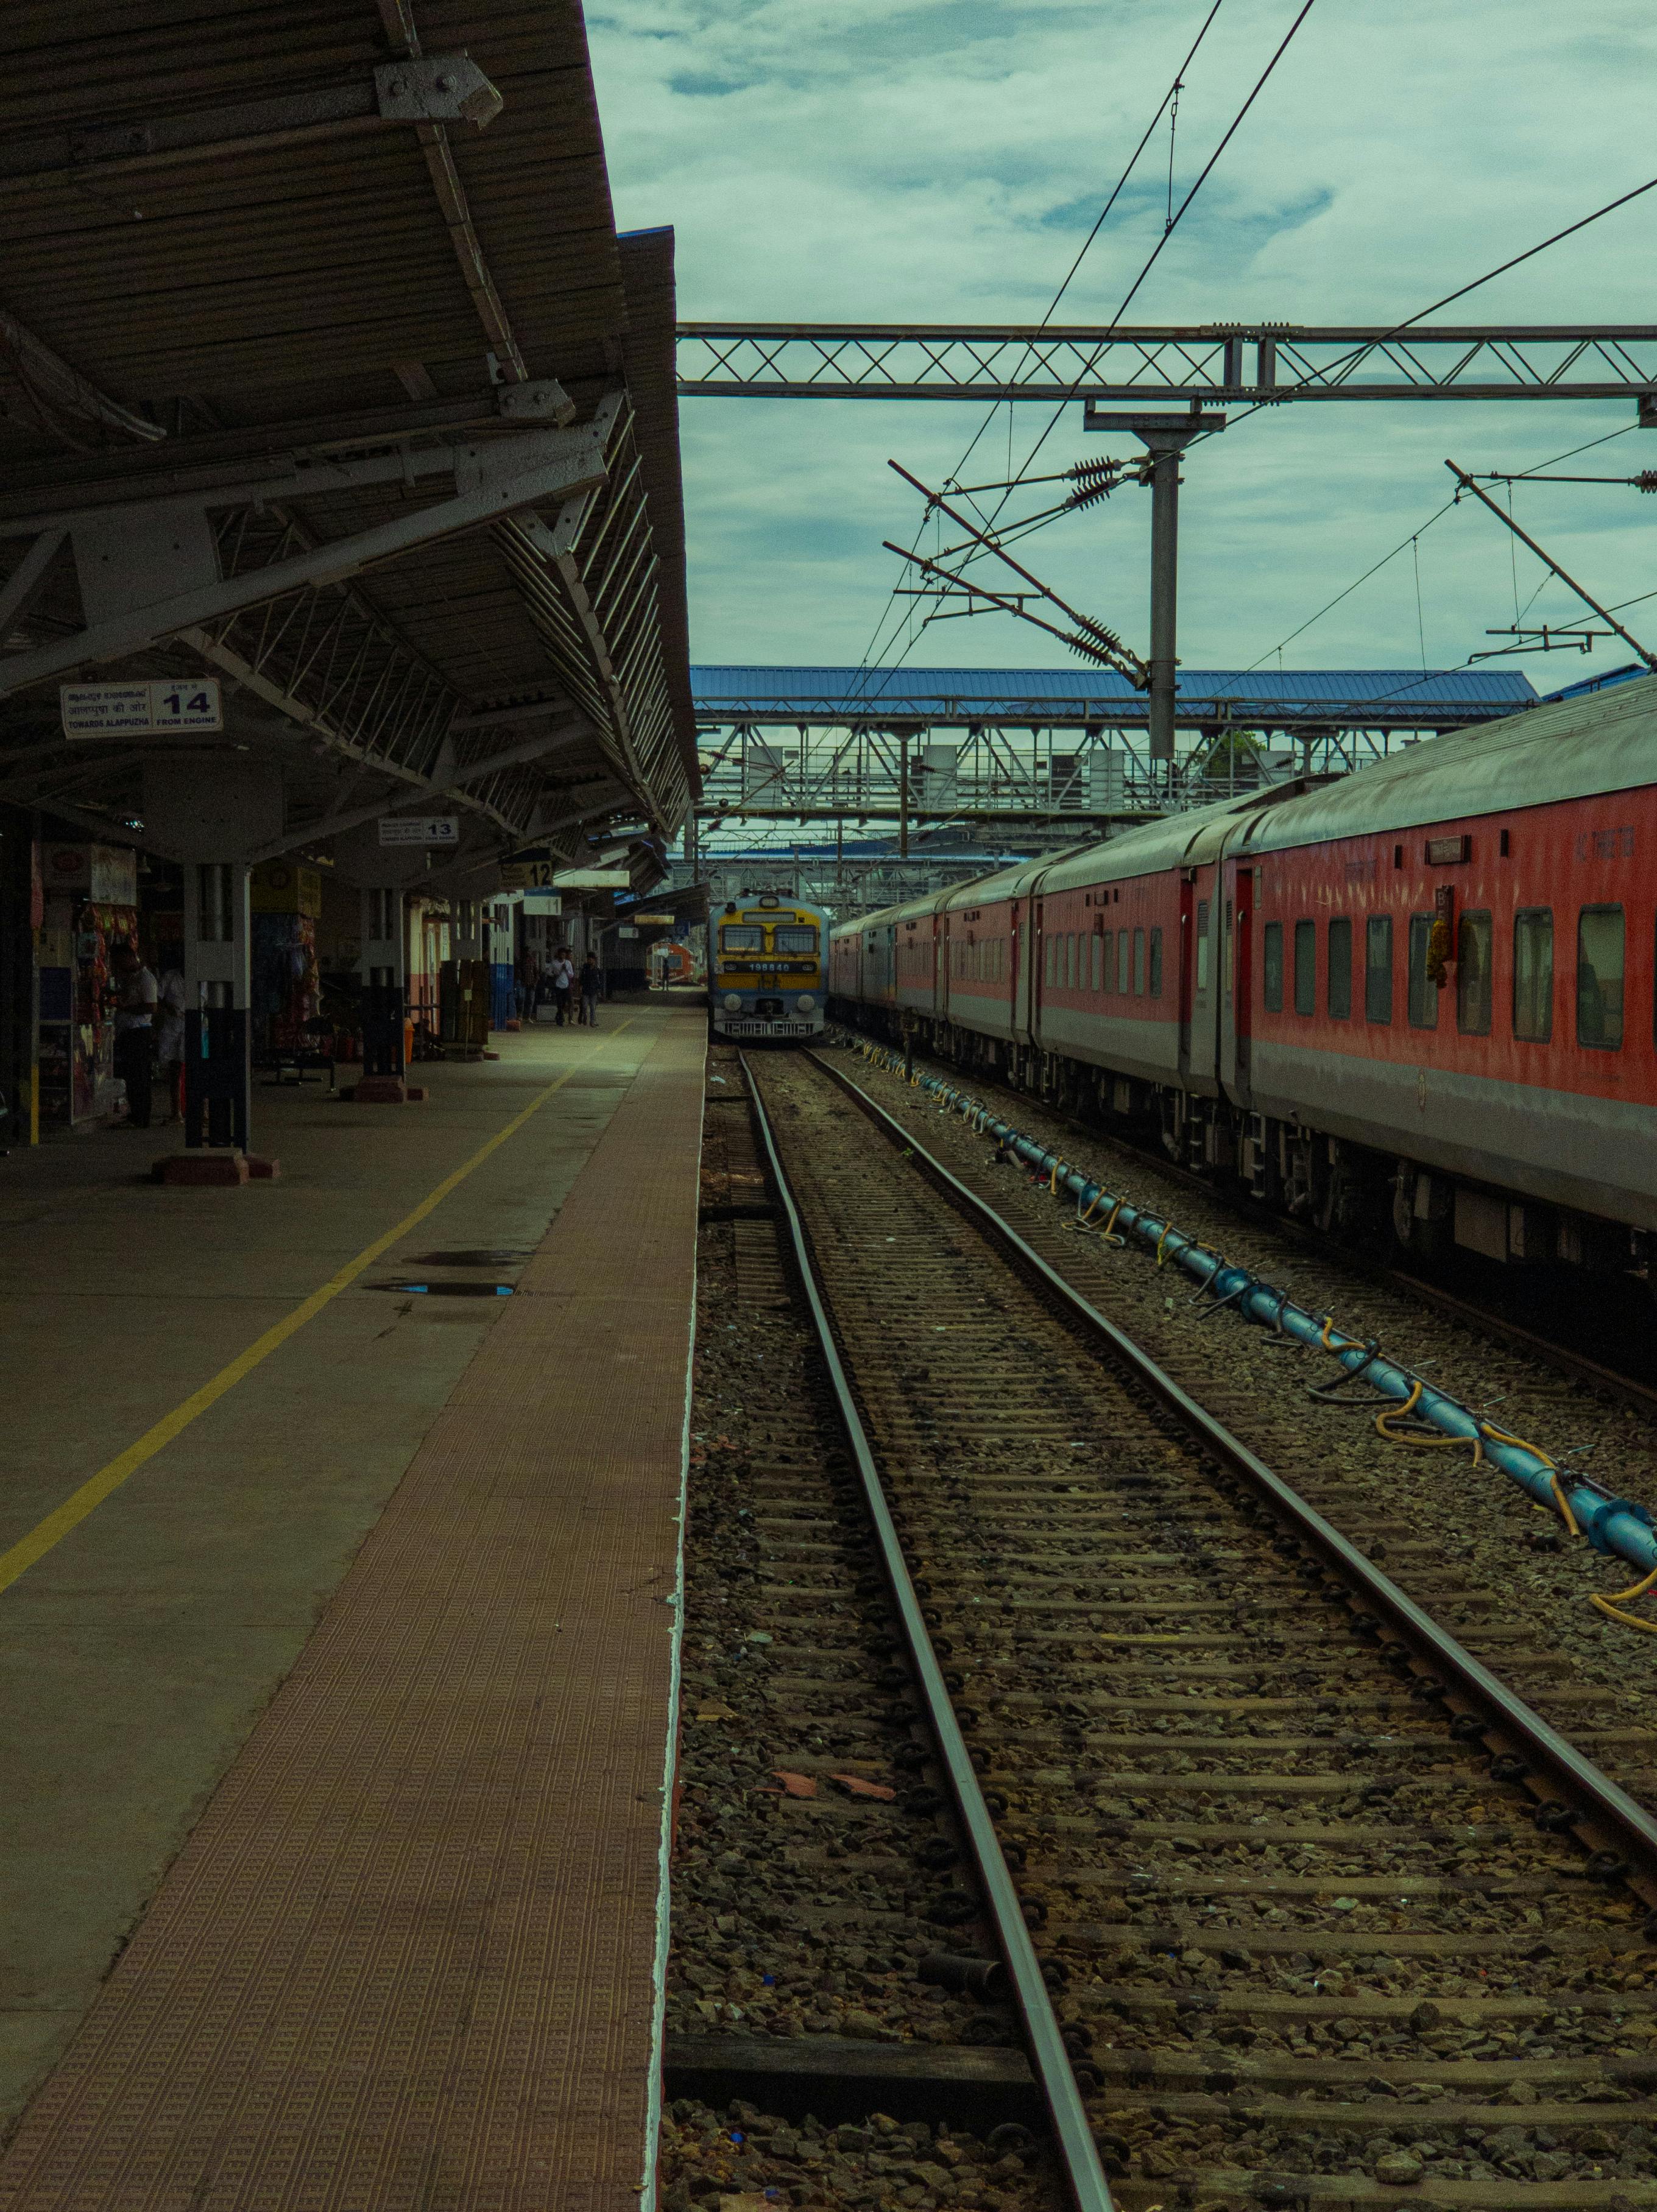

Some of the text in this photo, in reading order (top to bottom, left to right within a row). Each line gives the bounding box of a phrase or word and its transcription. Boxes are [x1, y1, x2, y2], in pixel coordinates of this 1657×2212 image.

[113, 702, 125, 712] की
[129, 700, 147, 712] ओर
[163, 692, 210, 714] 14
[68, 717, 149, 729] TOWARDS ALAPPUZHA
[184, 716, 216, 725] ENGINE
[428, 823, 451, 835] 13
[530, 863, 551, 886] 12
[546, 898, 559, 914] 11
[749, 963, 790, 972] 198840
